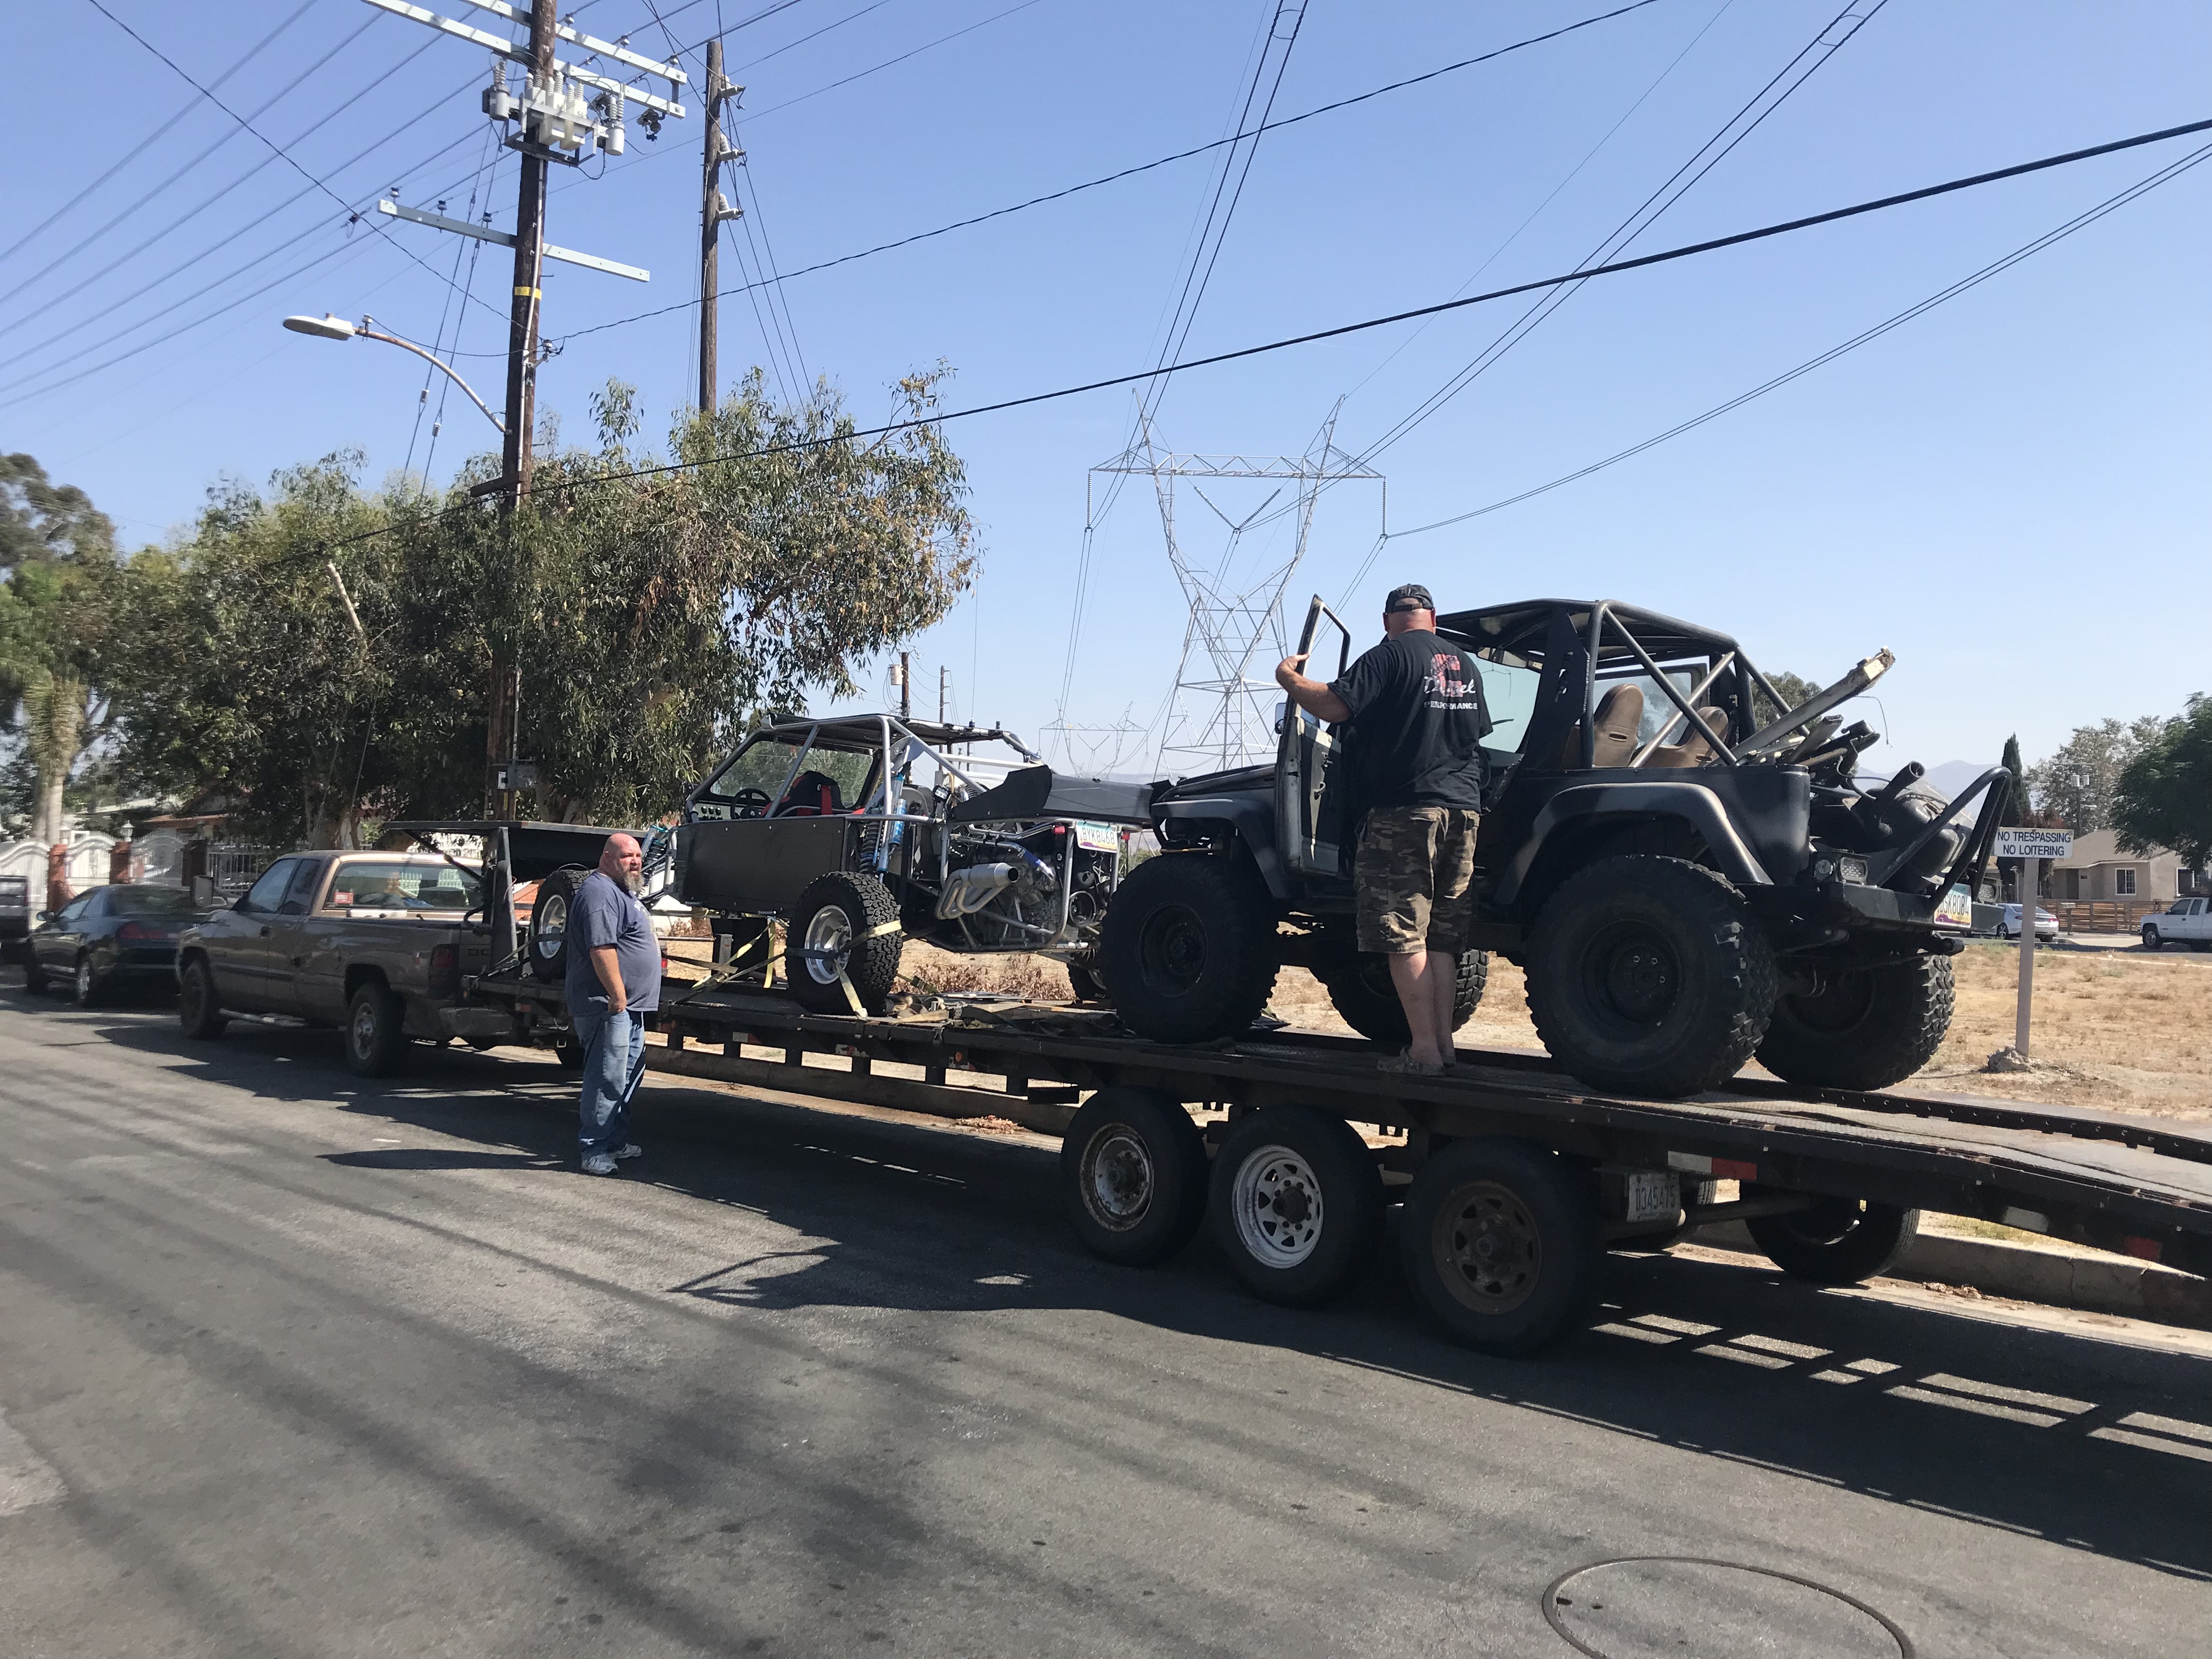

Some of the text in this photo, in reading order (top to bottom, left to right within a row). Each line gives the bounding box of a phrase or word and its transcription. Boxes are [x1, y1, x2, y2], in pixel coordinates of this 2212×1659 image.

[1082, 827, 1115, 845] BYK8468
[1997, 831, 2071, 843] NO TRESPASSING
[2003, 844, 2064, 856] NO LOITERING
